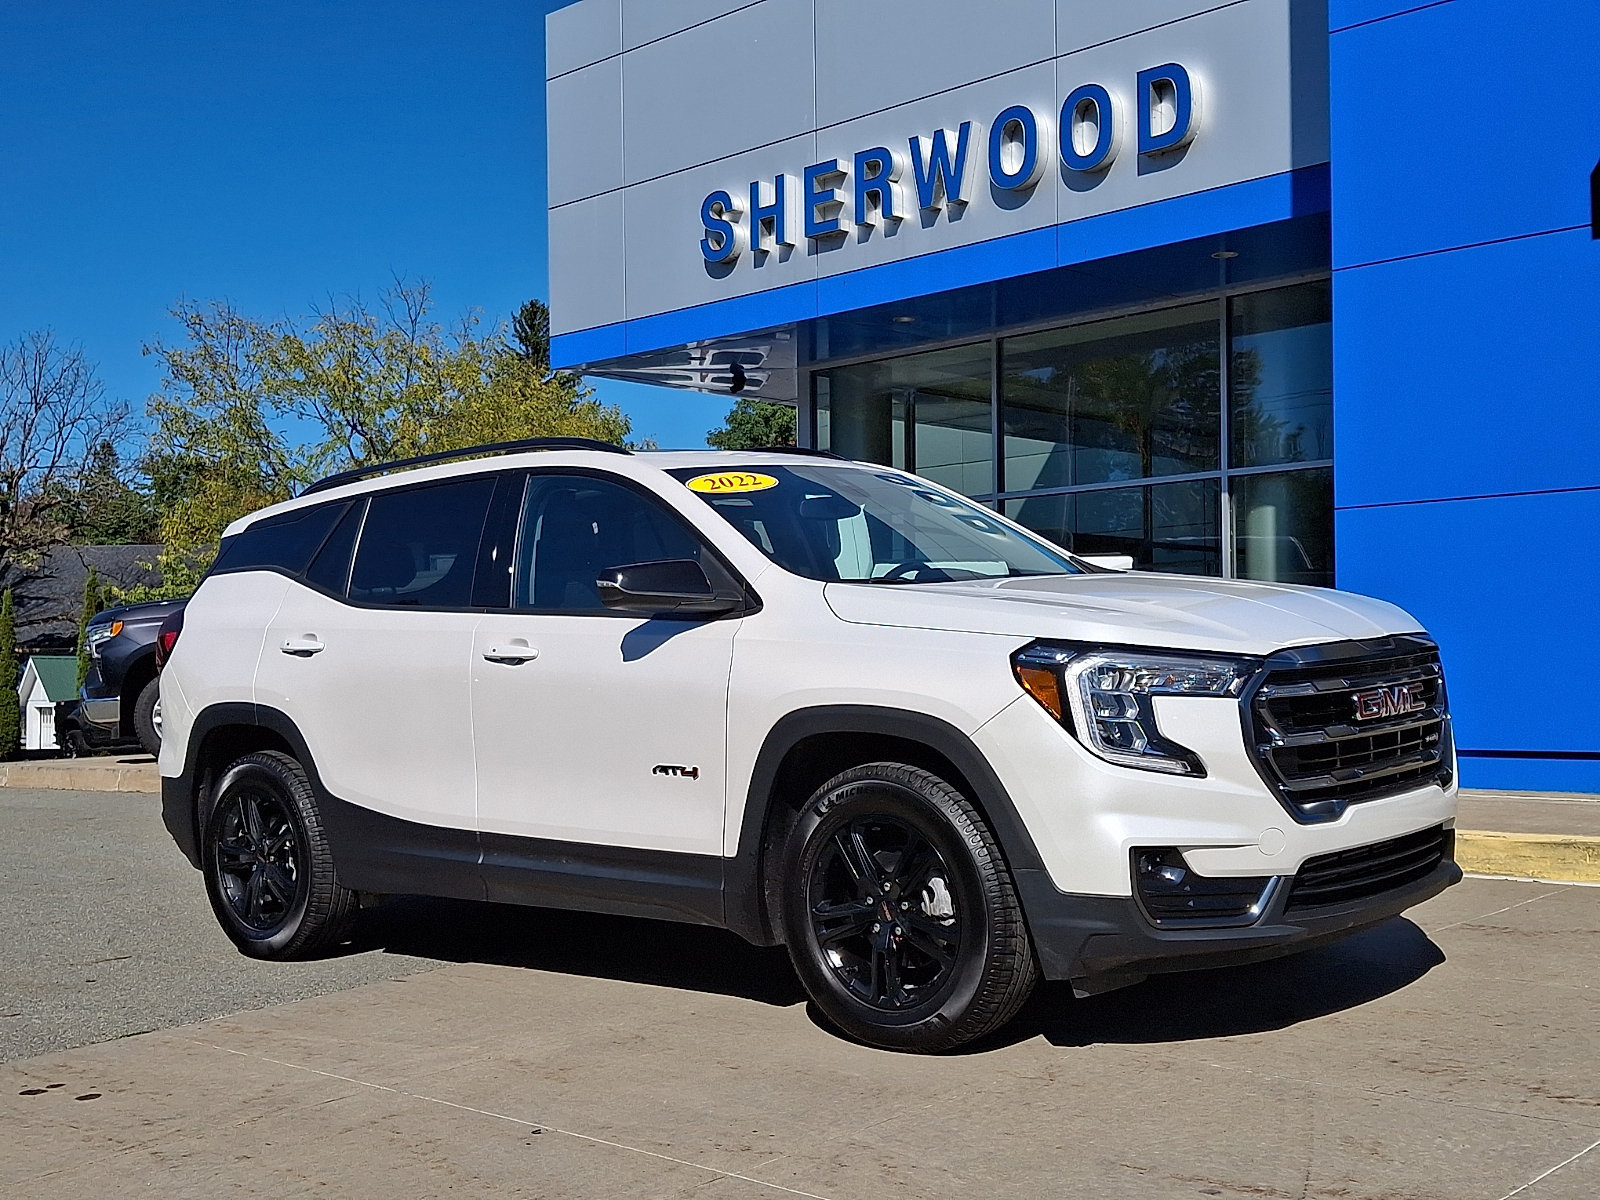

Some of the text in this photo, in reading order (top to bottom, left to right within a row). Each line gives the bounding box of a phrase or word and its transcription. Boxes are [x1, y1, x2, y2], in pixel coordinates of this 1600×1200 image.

[700, 62, 1199, 263] SHERWOOD
[703, 475, 762, 490] 2022
[1355, 683, 1426, 720] GMC
[652, 764, 699, 780] AT4
